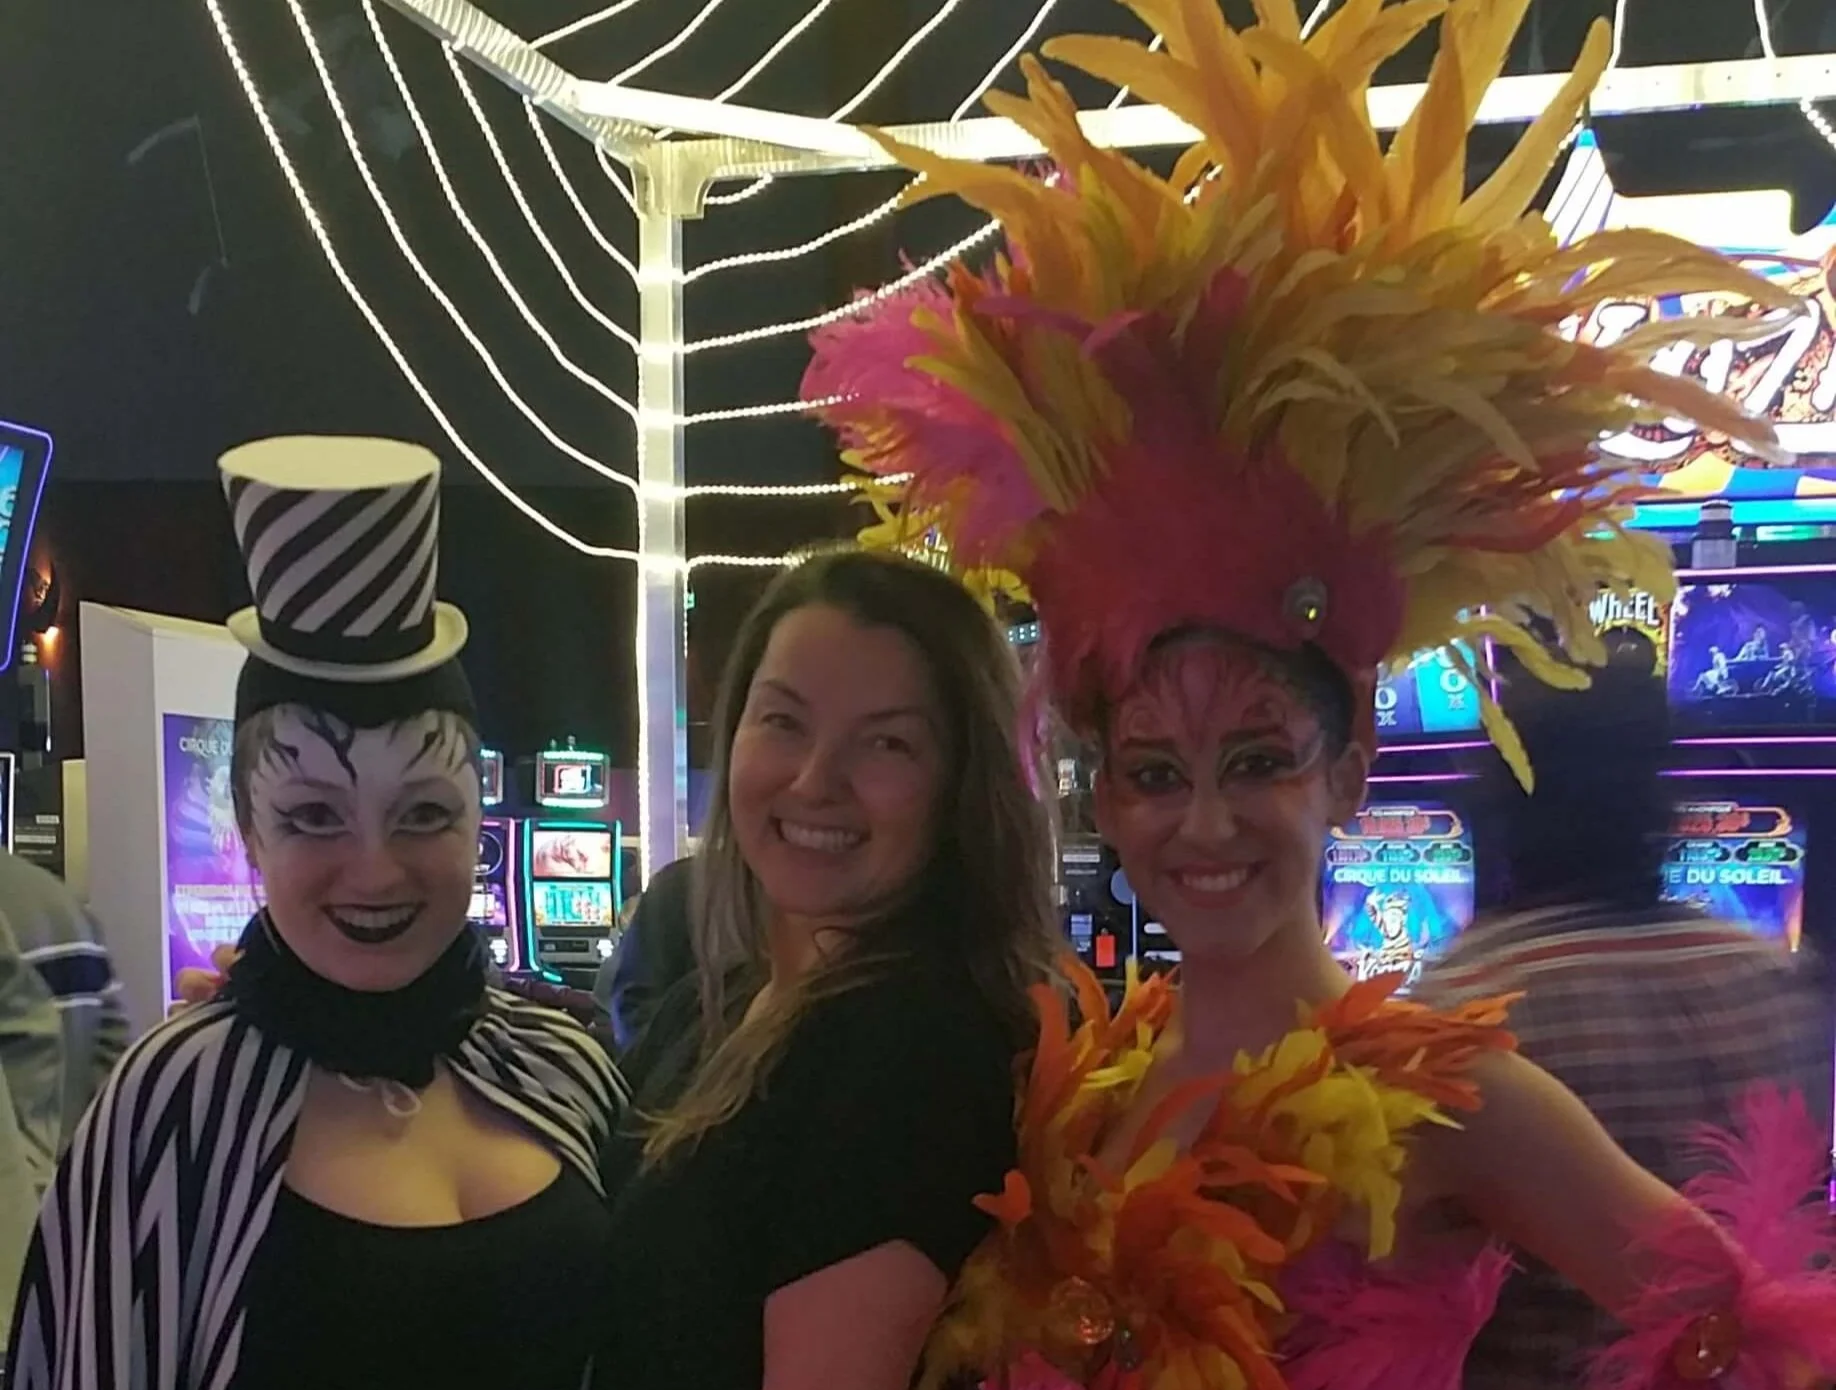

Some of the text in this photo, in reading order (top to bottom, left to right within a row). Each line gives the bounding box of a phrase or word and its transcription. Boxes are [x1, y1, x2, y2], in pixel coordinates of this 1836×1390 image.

[178, 736, 218, 758] CIRQUE
[1334, 868, 1466, 887] CIRQUE DU SOLEIL
[1686, 869, 1716, 884] DU
[1718, 868, 1789, 885] SOLEIL
